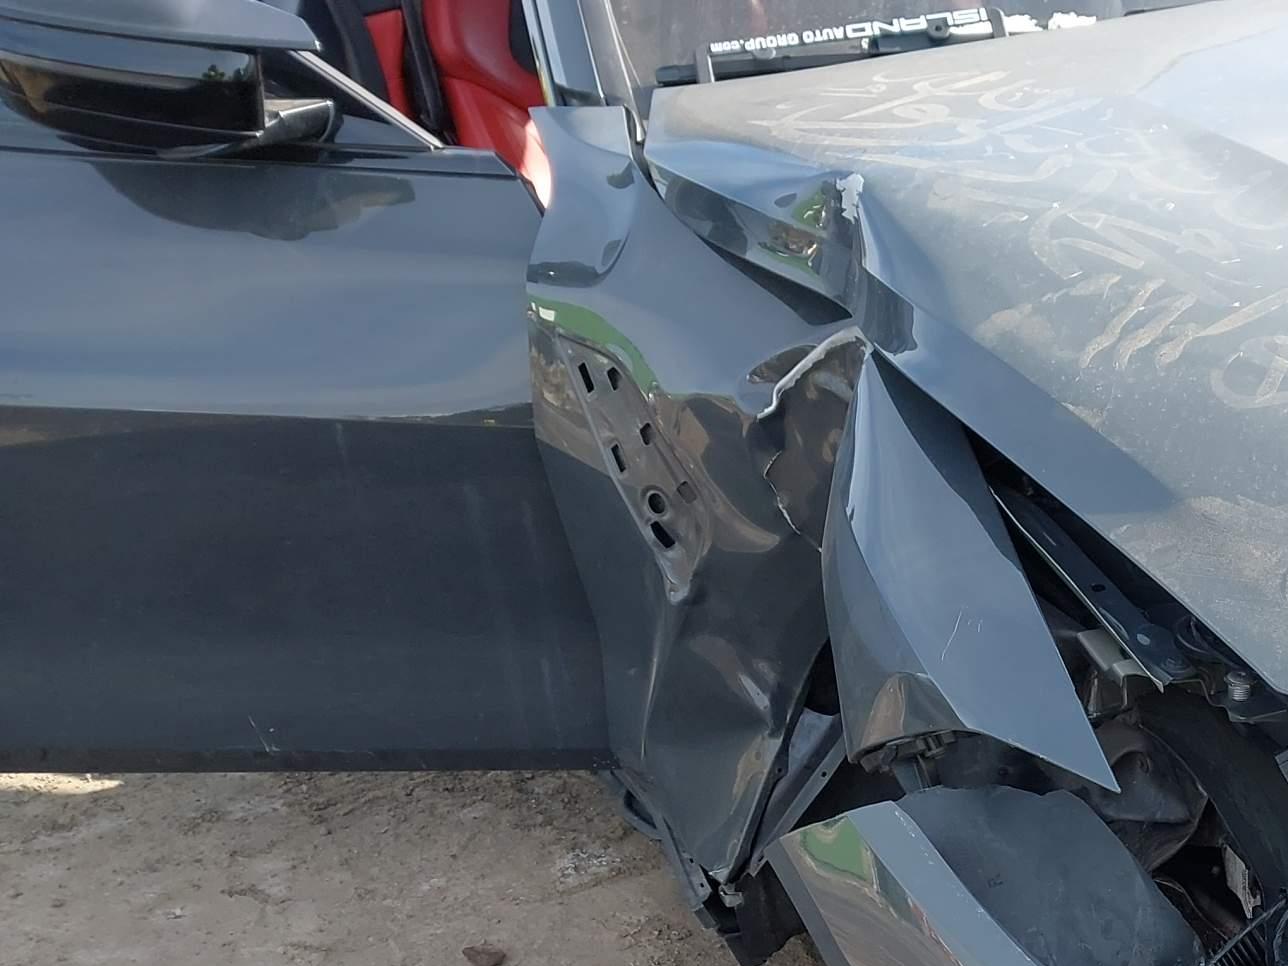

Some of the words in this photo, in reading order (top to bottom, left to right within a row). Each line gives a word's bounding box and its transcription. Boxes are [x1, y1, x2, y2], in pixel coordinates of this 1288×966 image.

[846, 7, 988, 38] ISLAND
[710, 31, 800, 52] GROUP.com
[803, 25, 844, 44] AUTO
